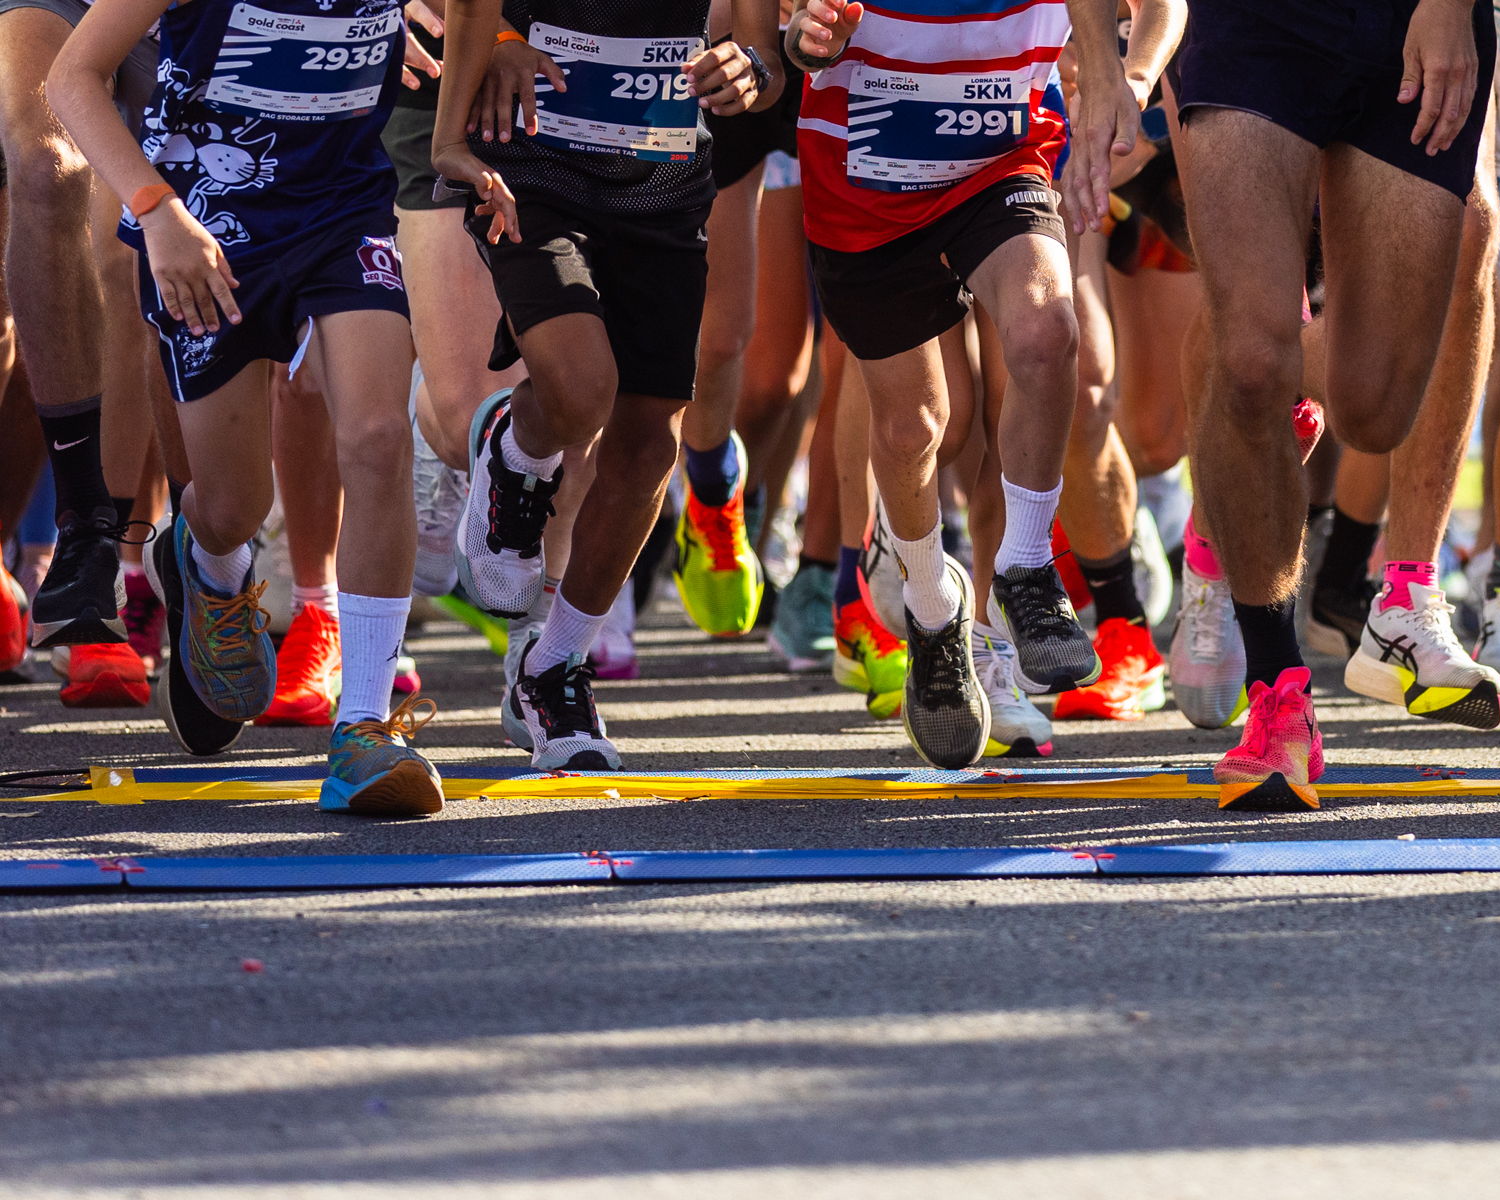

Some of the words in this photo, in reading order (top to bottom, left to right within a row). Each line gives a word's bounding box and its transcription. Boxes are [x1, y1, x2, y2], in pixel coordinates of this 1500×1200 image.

[247, 16, 274, 28] gold
[275, 22, 305, 32] coast
[345, 20, 388, 39] 5KM
[544, 35, 569, 48] gold
[571, 41, 600, 54] coast
[300, 41, 389, 71] 2938
[642, 47, 688, 63] 5KM
[610, 72, 690, 100] 2919
[864, 78, 888, 90] gold
[890, 81, 920, 92] coast
[963, 83, 1012, 100] 5KM
[934, 108, 1022, 136] 2991
[569, 142, 585, 150] BAG
[586, 145, 621, 154] STORAGE
[622, 148, 637, 157] TAG
[918, 181, 952, 190] STORAGE
[1005, 190, 1049, 206] PUMA
[365, 273, 380, 281] SEQ
